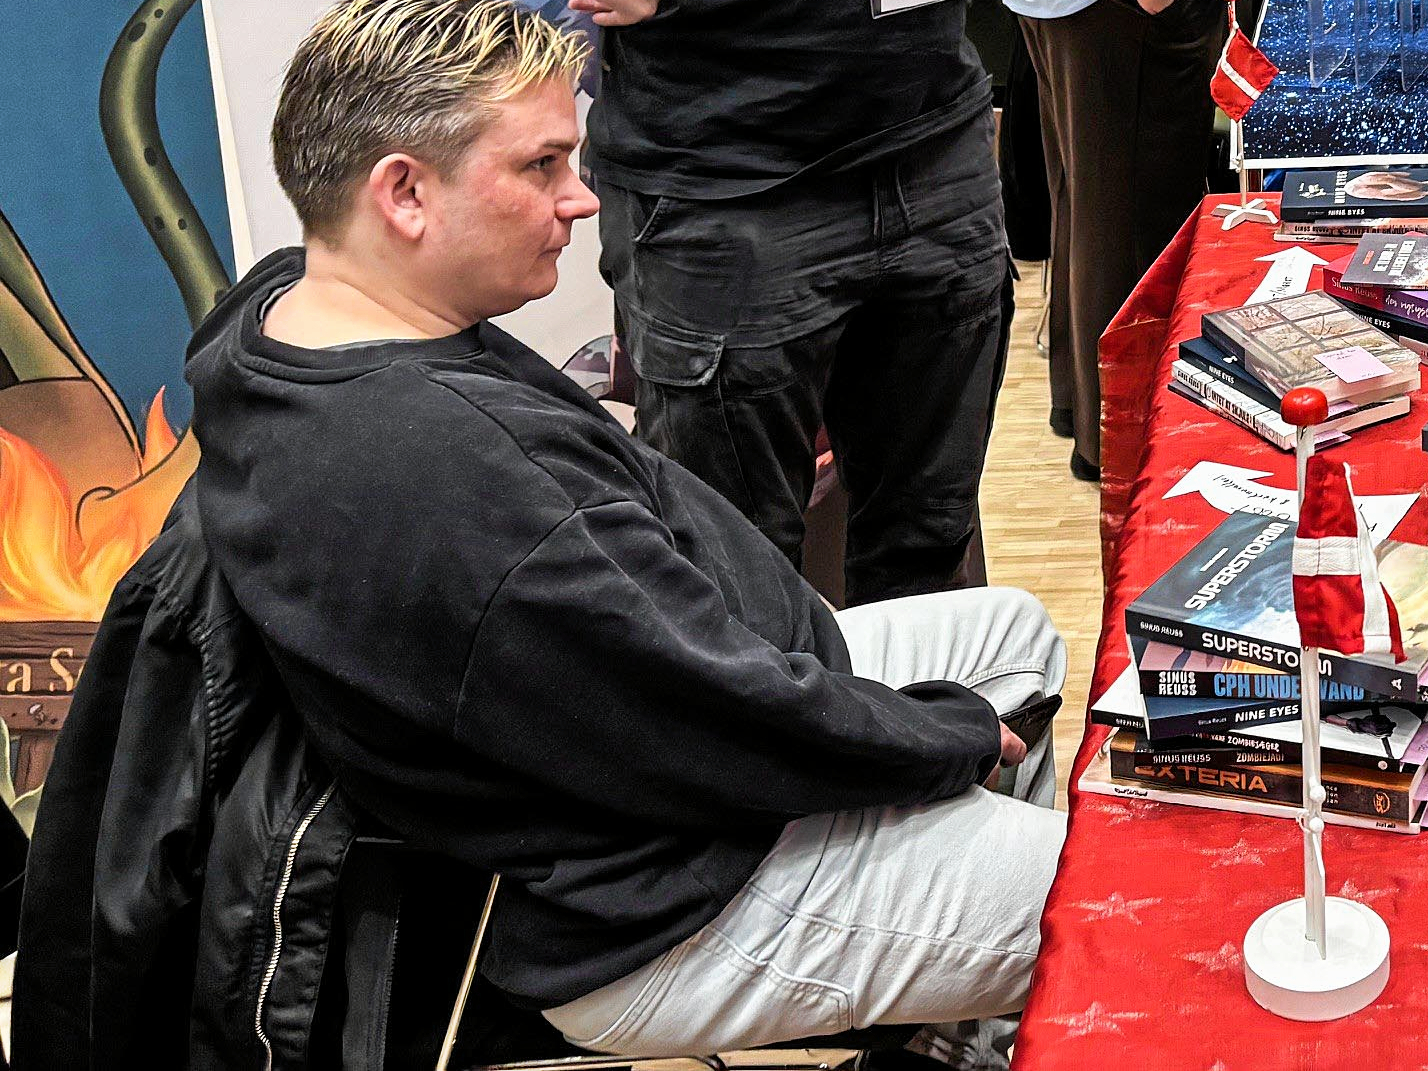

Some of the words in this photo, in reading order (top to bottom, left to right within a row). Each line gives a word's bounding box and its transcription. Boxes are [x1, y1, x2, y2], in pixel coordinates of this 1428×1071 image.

[1374, 317, 1391, 328] EYES
[1221, 370, 1235, 384] EYES
[1184, 523, 1289, 610] SUPERSTORM
[1202, 632, 1332, 676] SUPERSTOM
[1159, 671, 1196, 684] SINUS
[1159, 683, 1197, 696] REUSS
[1214, 674, 1250, 697] CPH
[1254, 674, 1300, 698] UNDE
[1234, 709, 1266, 723] NINE
[1269, 704, 1300, 719] EYES
[1227, 736, 1280, 752] ZOMBIEJÆGER
